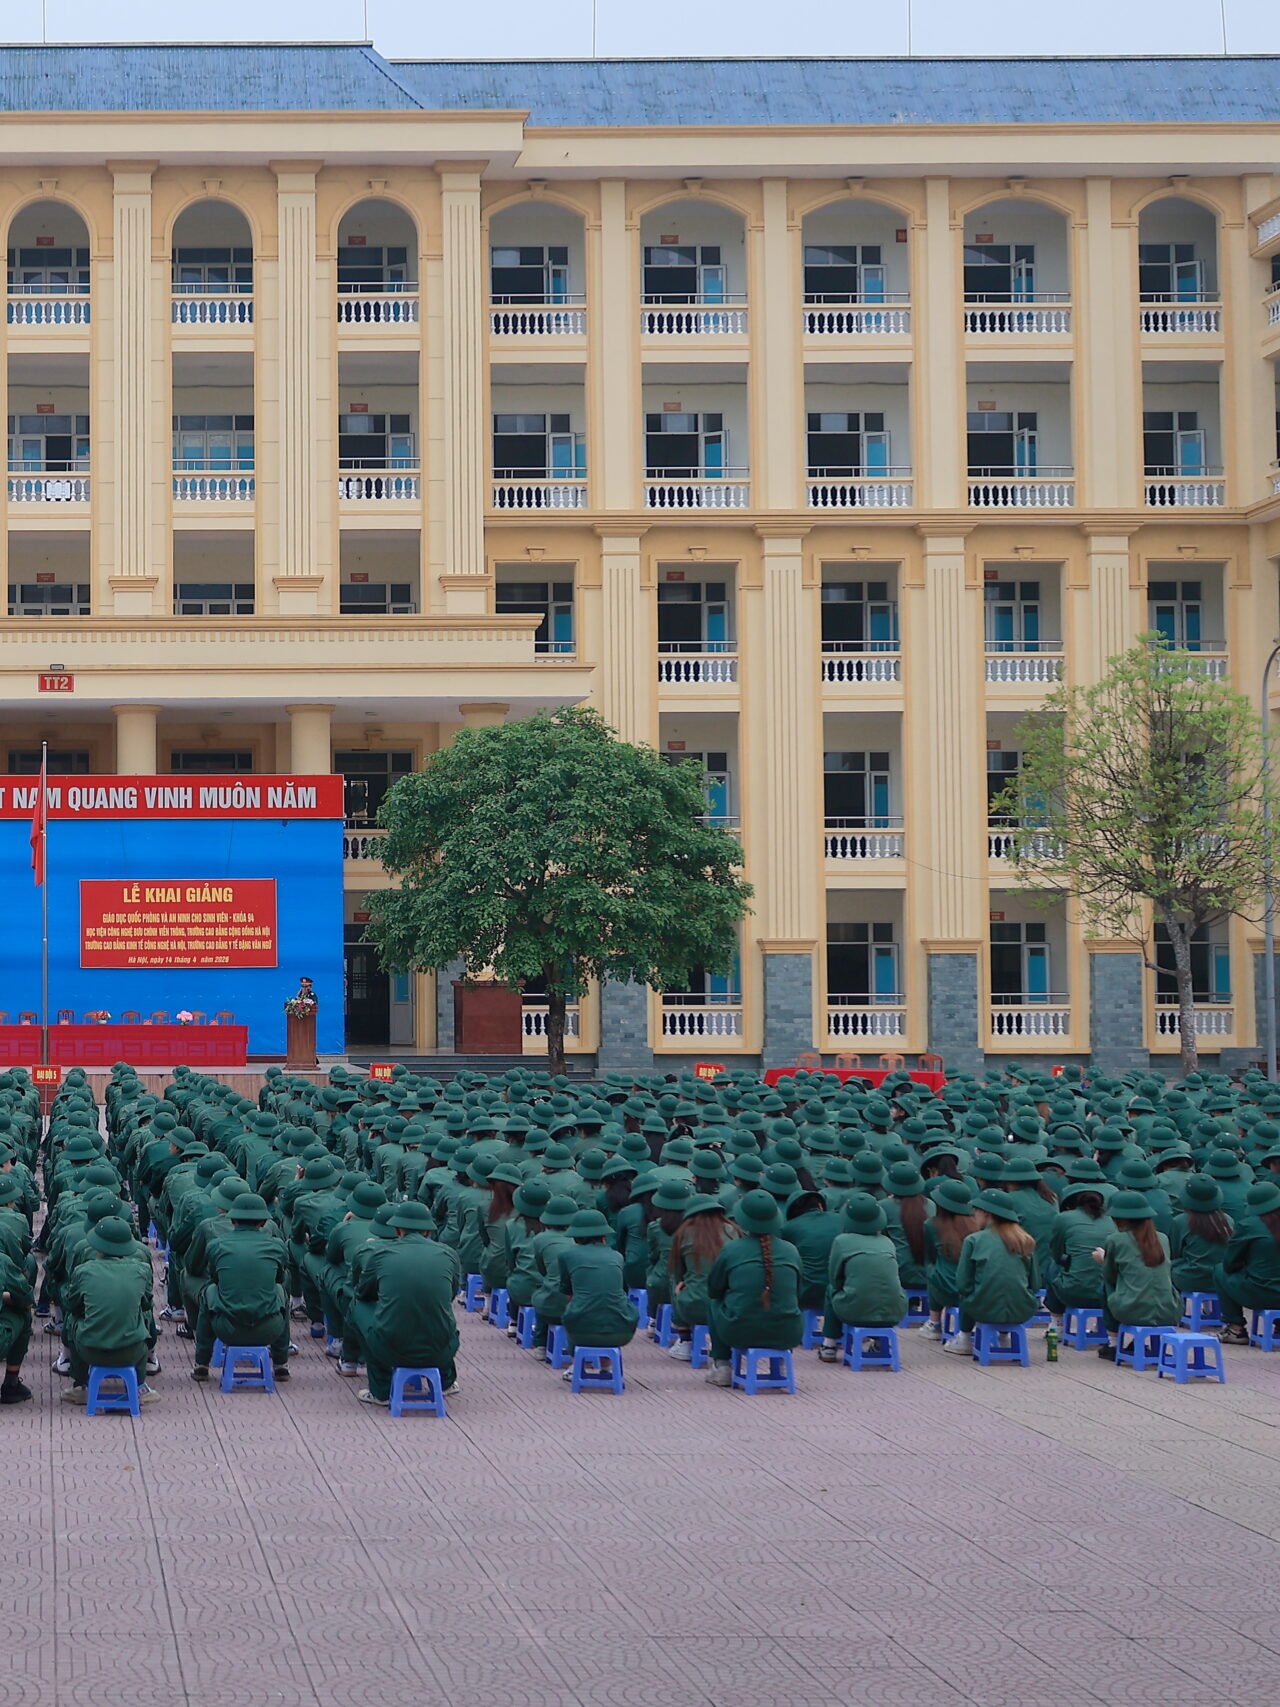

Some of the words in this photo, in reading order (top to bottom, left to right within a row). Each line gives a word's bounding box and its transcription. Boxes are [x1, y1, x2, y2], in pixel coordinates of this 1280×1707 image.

[44, 676, 68, 690] TT2
[68, 786, 138, 811] QUANG
[144, 787, 192, 809] VINH
[199, 782, 260, 809] MUÔN
[268, 782, 317, 809] NĂM
[123, 882, 141, 902] LỄ
[146, 888, 181, 902] KHAI
[186, 882, 233, 902] GIẢNG
